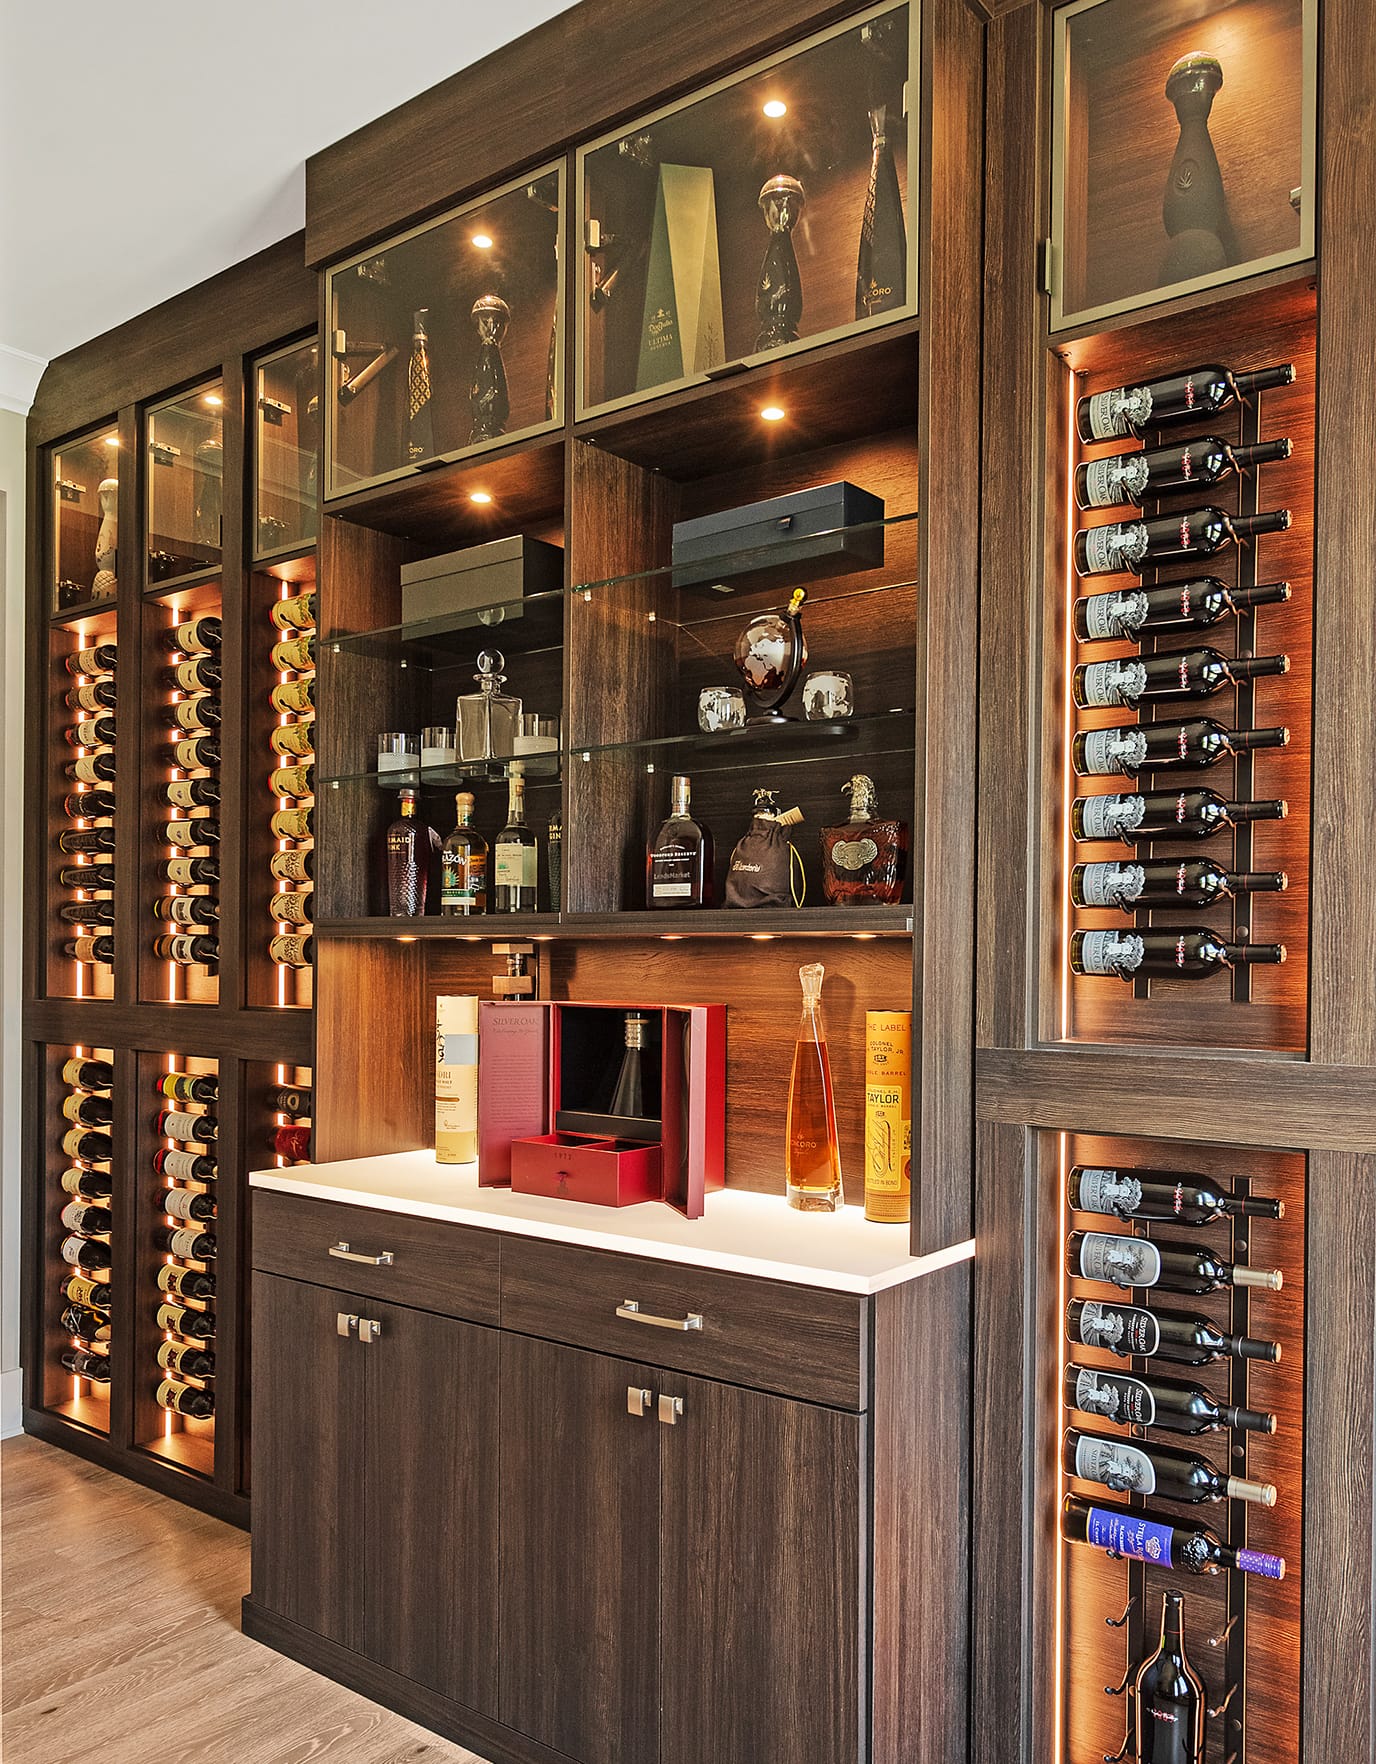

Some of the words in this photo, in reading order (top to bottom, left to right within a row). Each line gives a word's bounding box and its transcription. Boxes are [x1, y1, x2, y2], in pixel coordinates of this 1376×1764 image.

[1100, 394, 1109, 418] SILVER
[1102, 417, 1111, 433] OAK
[1097, 462, 1106, 486] SILVER
[1098, 486, 1107, 502] OAK
[1096, 530, 1105, 554] SILVER
[1098, 553, 1107, 568] OAK
[1097, 596, 1106, 618] SILVER
[1099, 617, 1107, 634] OAK
[1095, 664, 1104, 688] SILVER
[1096, 687, 1105, 704] OAK
[1096, 733, 1104, 756] SILVER
[1096, 755, 1105, 771] OAK
[492, 1017, 520, 1025] SILVER
[880, 1024, 907, 1032] LABEL
[867, 1092, 899, 1105] TAYLOR
[1090, 1173, 1099, 1195] SILVER
[1095, 1239, 1105, 1263] SILVER
[1139, 1315, 1149, 1339] SILVER
[1138, 1338, 1147, 1352] OAK
[1135, 1387, 1144, 1411] SILVER
[1136, 1522, 1146, 1546] STELLA
